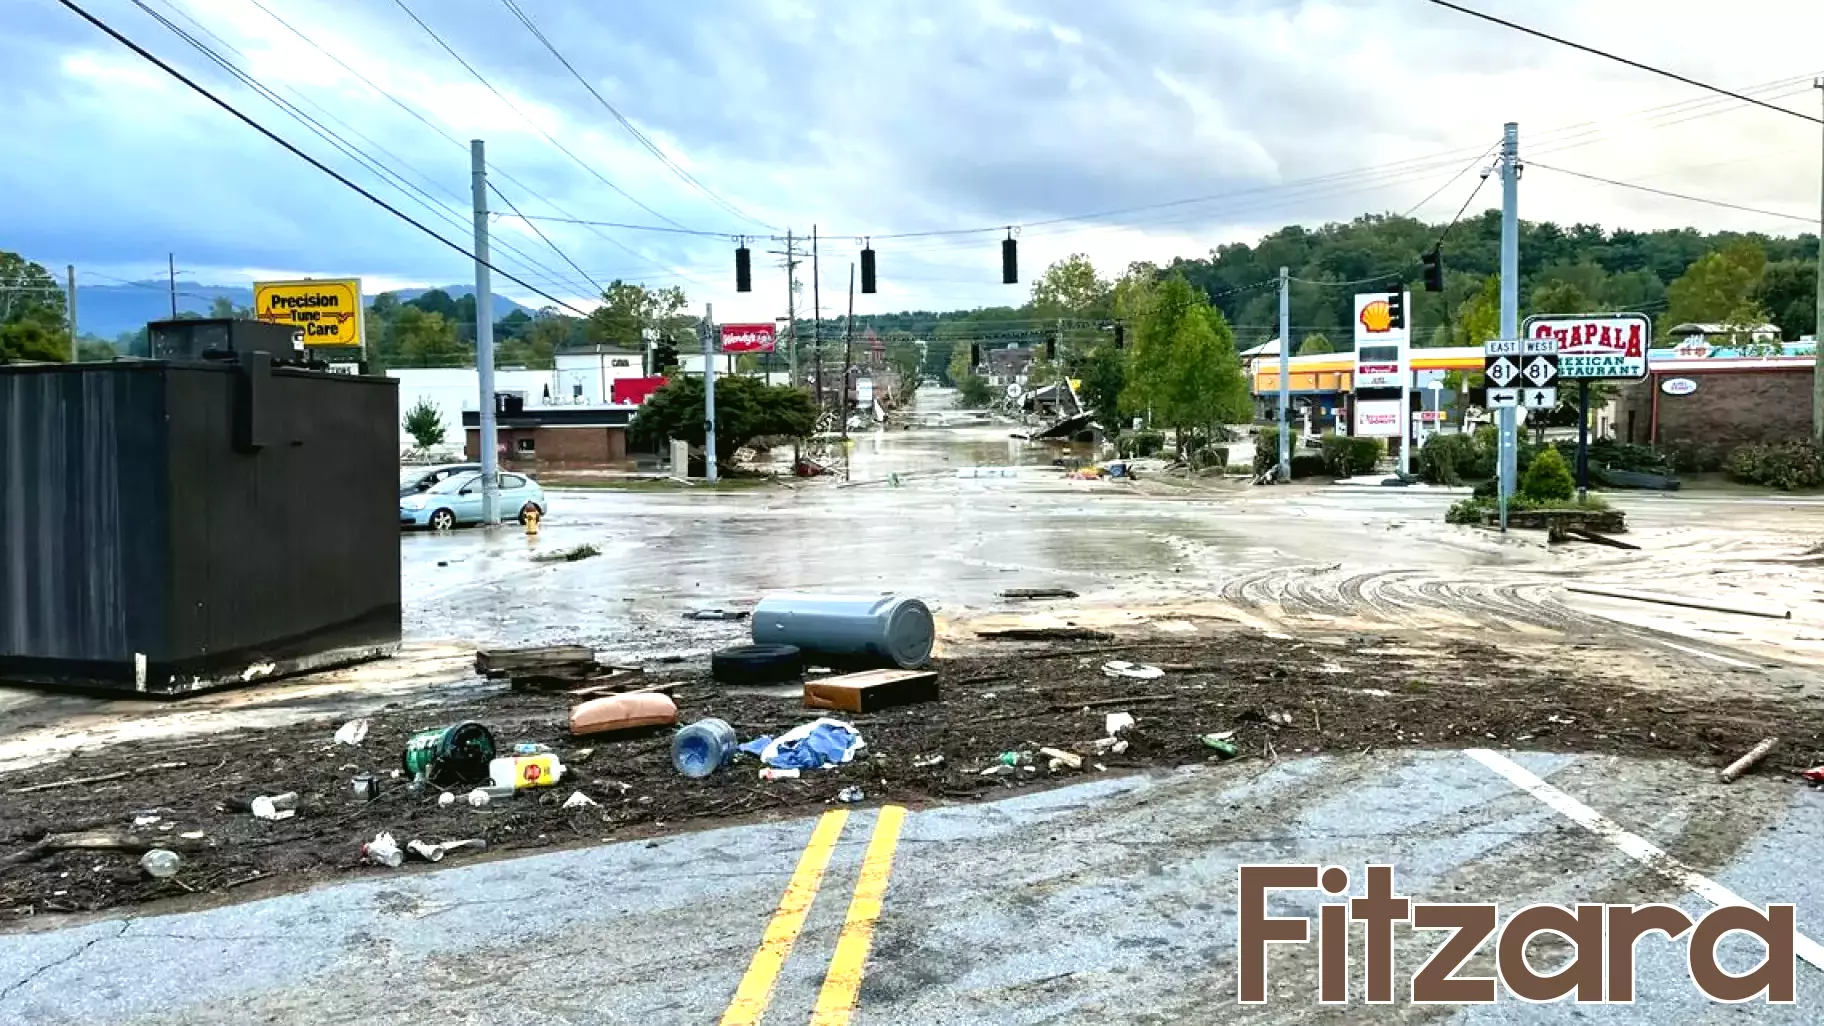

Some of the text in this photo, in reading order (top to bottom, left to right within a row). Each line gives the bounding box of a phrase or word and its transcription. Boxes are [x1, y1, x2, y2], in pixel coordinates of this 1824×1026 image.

[271, 293, 339, 309] Precision
[289, 308, 321, 321] Tune
[306, 322, 339, 336] Care
[1490, 341, 1516, 353] EAST
[1527, 341, 1553, 353] WEST
[1492, 364, 1511, 379] 81
[1529, 364, 1548, 379] 81
[1558, 365, 1641, 376] STAURANT
